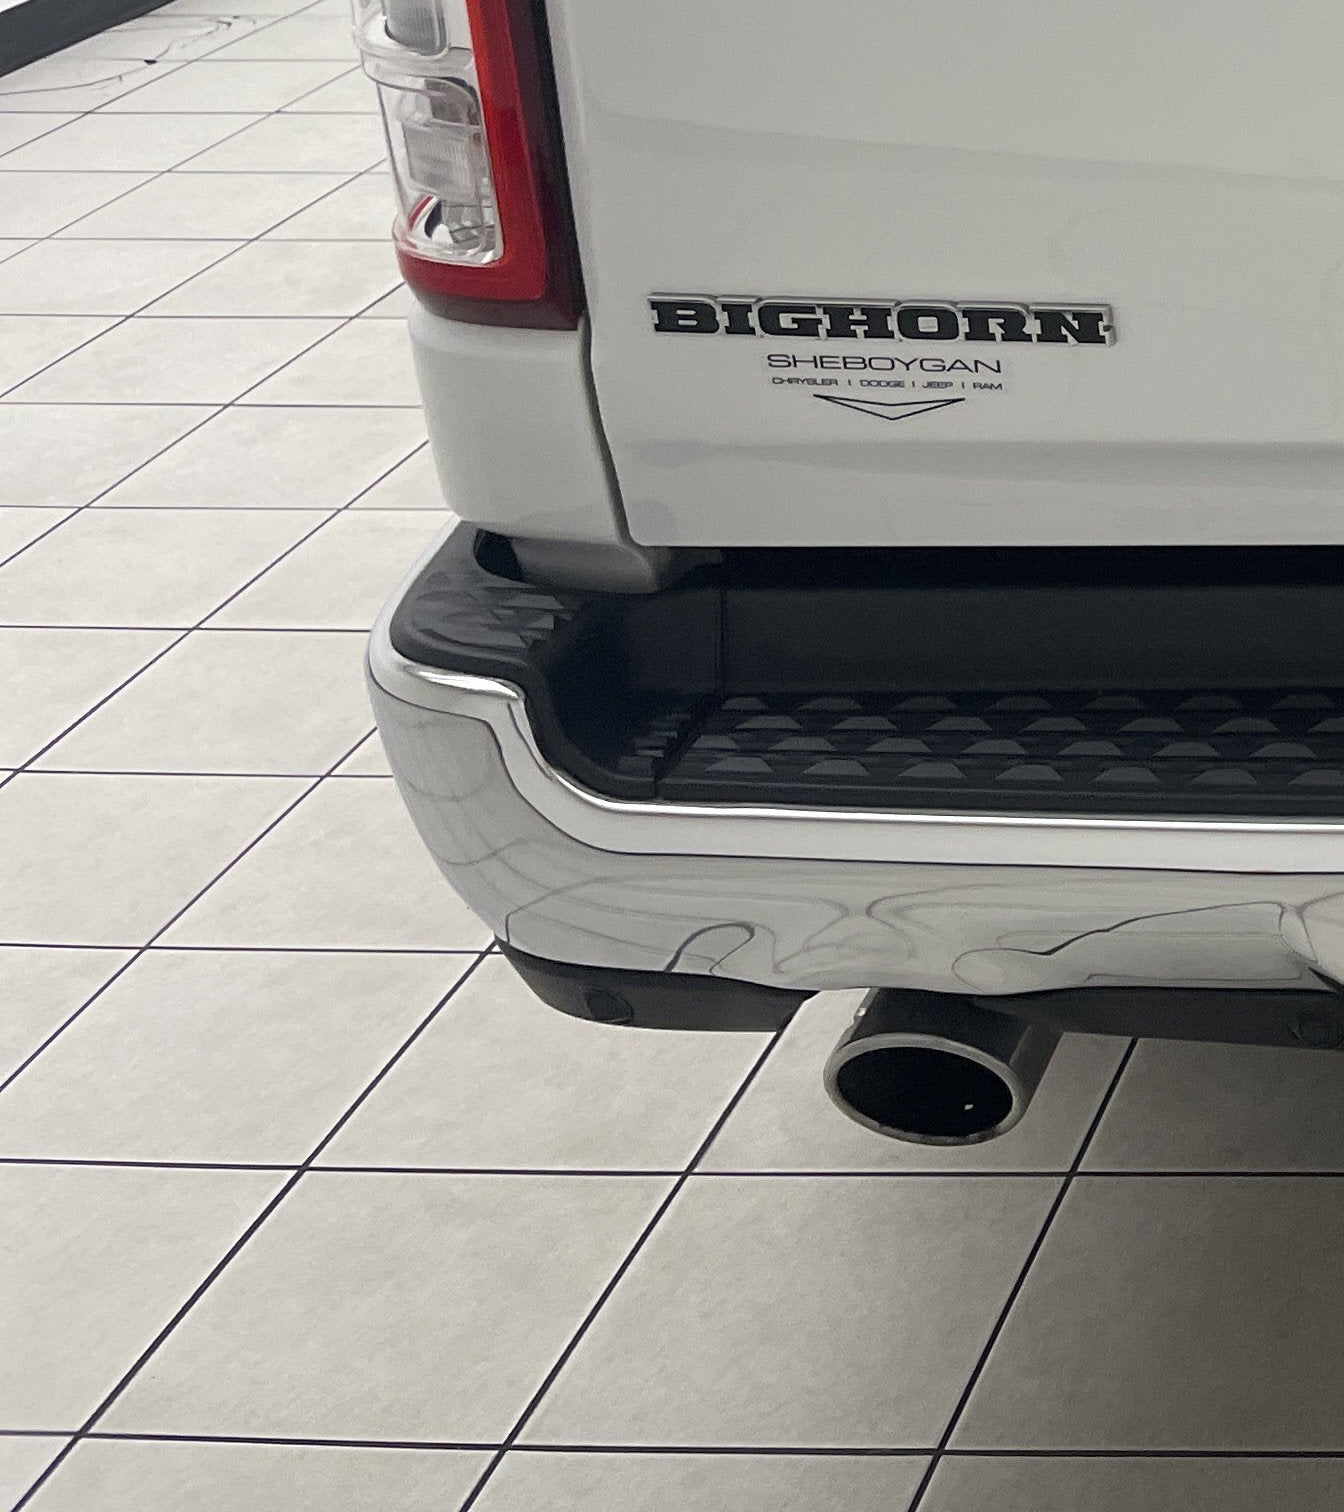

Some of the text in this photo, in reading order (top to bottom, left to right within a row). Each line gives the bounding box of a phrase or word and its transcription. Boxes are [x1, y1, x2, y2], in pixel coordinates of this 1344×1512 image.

[647, 291, 1117, 346] BIGHORN
[766, 353, 1002, 374] SHEBOYGAN
[771, 377, 1003, 390] CHRYSLER DODGE JEEP RAM
